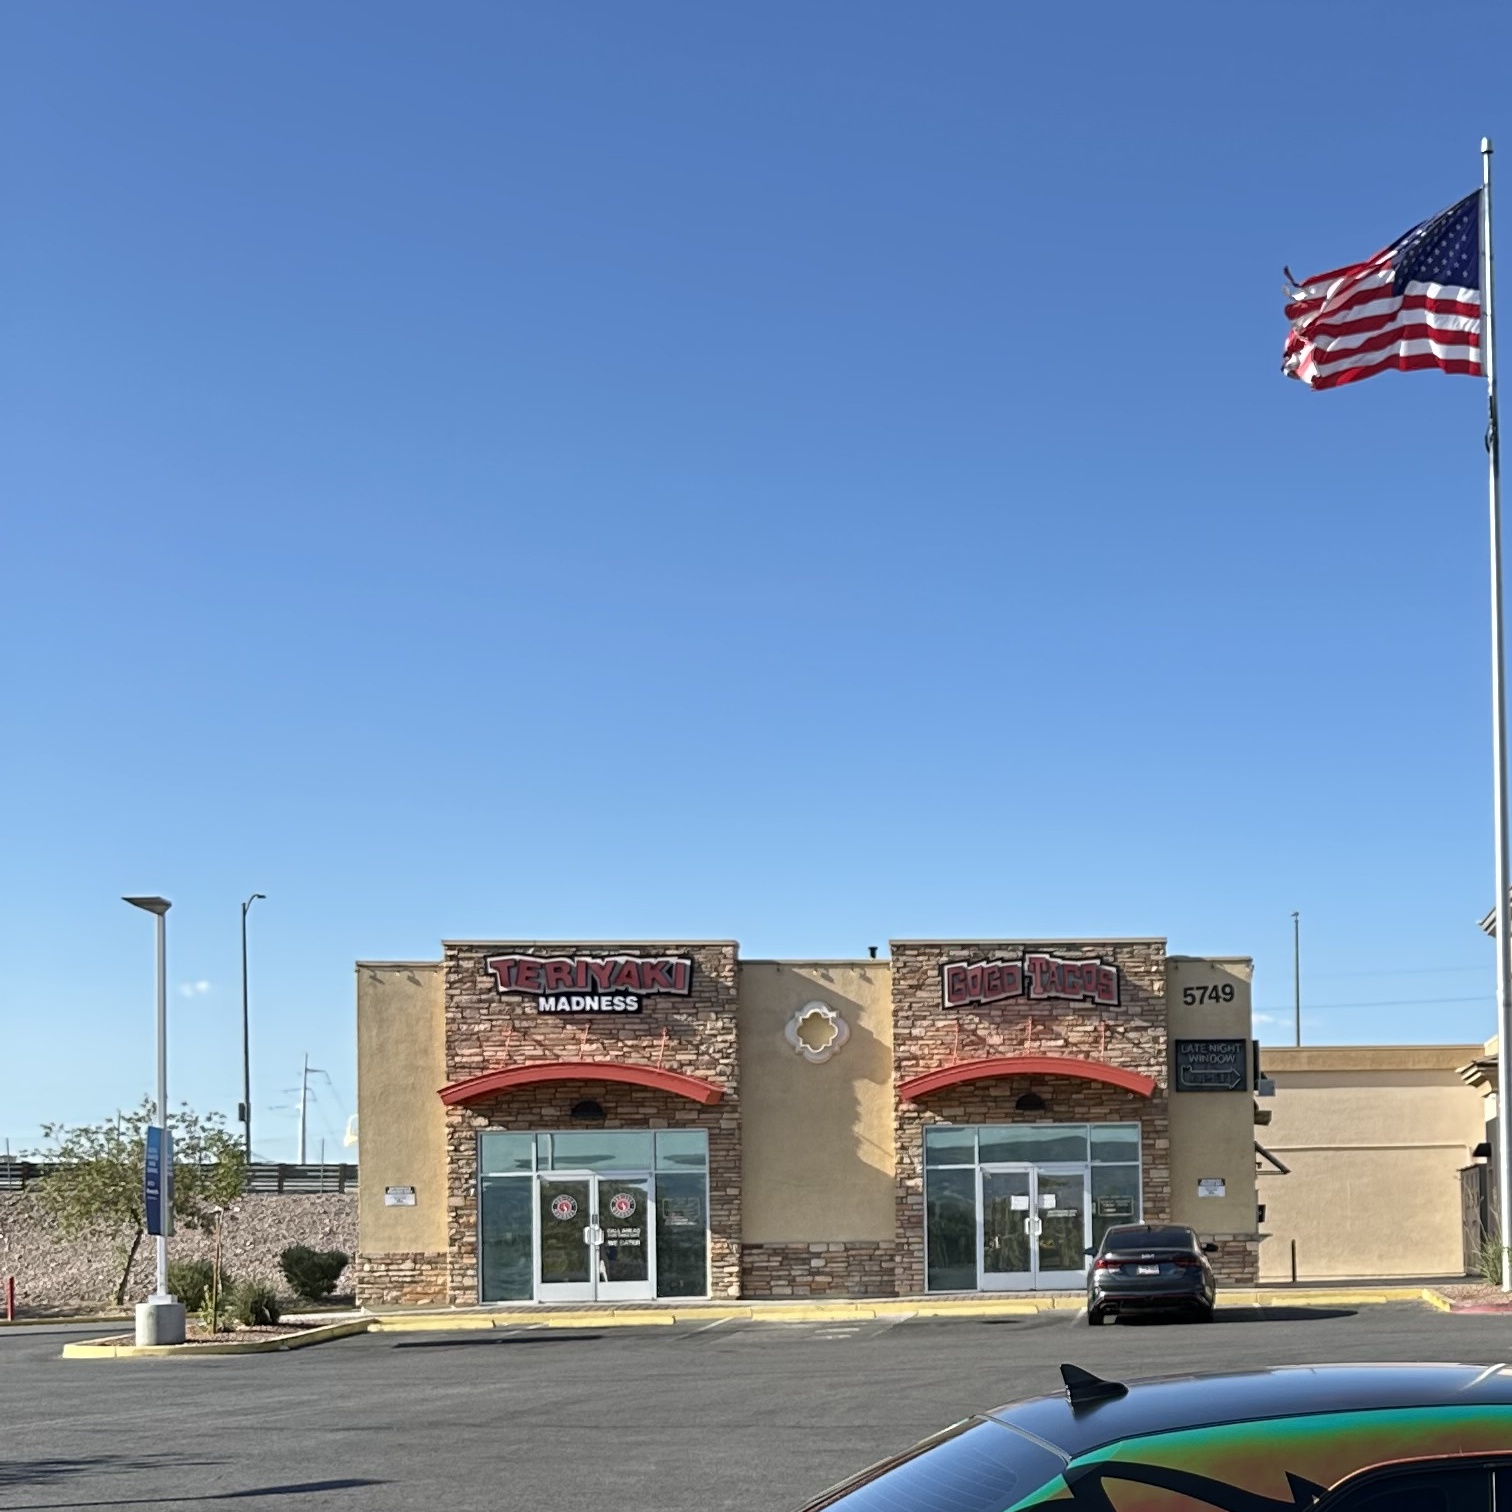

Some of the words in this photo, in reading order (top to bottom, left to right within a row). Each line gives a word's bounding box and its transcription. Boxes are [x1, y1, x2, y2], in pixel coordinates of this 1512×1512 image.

[487, 955, 691, 995] TERIYAKI
[944, 962, 1022, 1007] GOGO
[1025, 953, 1119, 1005] TACOS
[538, 996, 639, 1012] MADNESS
[1183, 983, 1235, 1006] 5749
[1181, 1043, 1207, 1053] LATE
[1209, 1043, 1242, 1053] NIGHT
[1188, 1054, 1235, 1063] WINDOW
